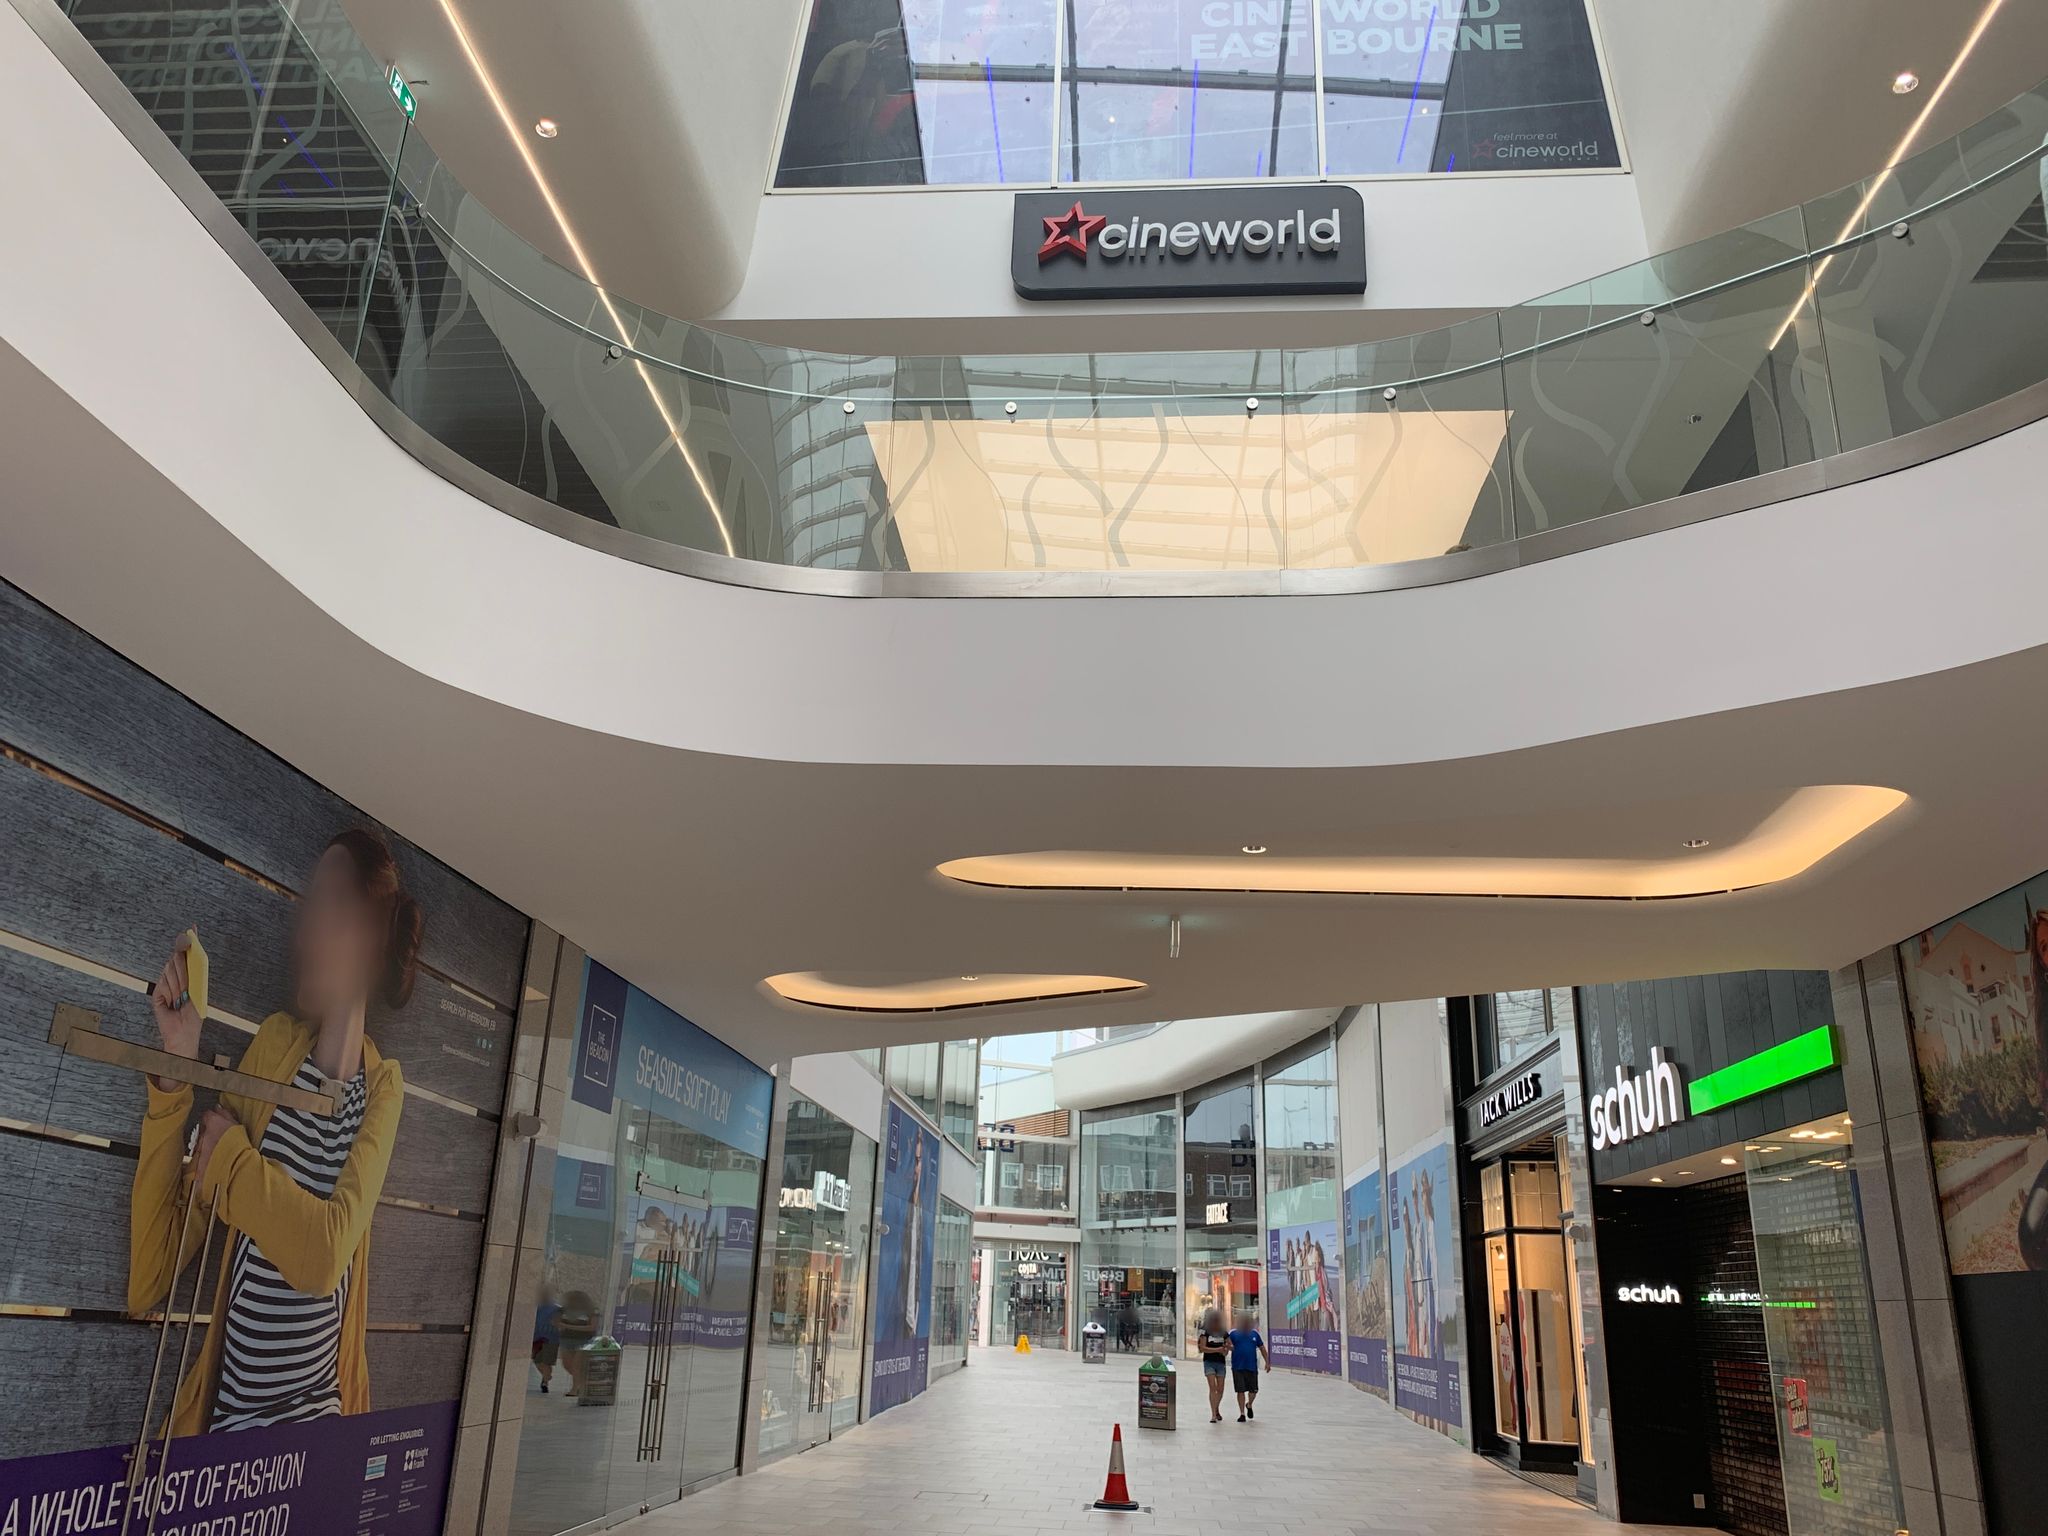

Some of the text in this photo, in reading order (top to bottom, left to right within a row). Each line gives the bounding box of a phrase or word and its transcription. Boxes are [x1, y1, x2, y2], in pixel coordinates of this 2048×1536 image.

[1200, 0, 1502, 28] CINE WORLD
[1190, 24, 1524, 60] EAST BOURNE
[1495, 141, 1599, 158] cineworld
[1098, 208, 1341, 258] cineworld
[636, 1044, 732, 1125] SEASIDE SOFT PLAY
[1480, 1072, 1535, 1128] JACK WILLS
[1590, 1046, 1681, 1151] schuh
[1618, 1284, 1680, 1303] schuh
[1, 1498, 19, 1536] A
[30, 1481, 125, 1536] WHOLE
[132, 1470, 195, 1520] HOST
[193, 1463, 225, 1509] OF
[224, 1451, 307, 1503] FASHION
[241, 1503, 290, 1536] FOOD
